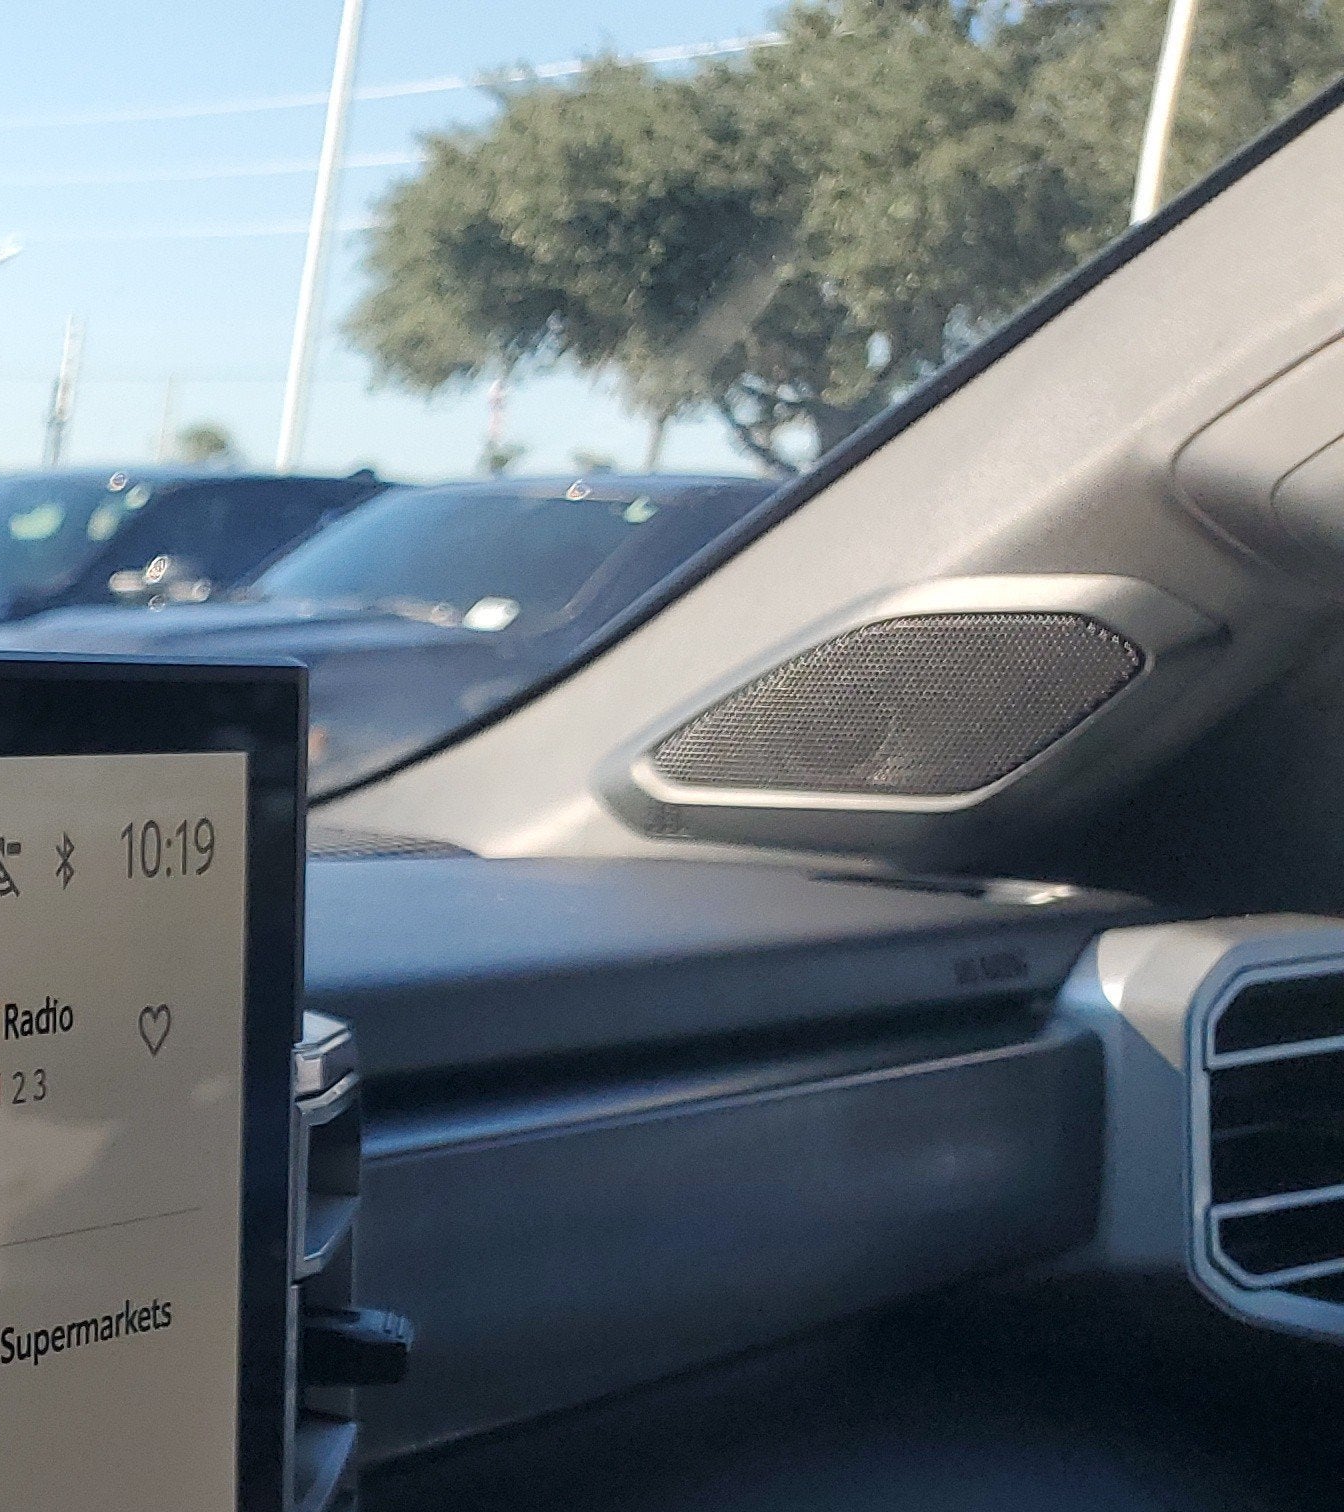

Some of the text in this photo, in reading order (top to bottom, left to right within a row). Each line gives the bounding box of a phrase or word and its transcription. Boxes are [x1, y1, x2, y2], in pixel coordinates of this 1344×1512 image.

[120, 817, 215, 879] 10:19
[4, 995, 74, 1041] Radio
[0, 1298, 173, 1366] Supermarkets
